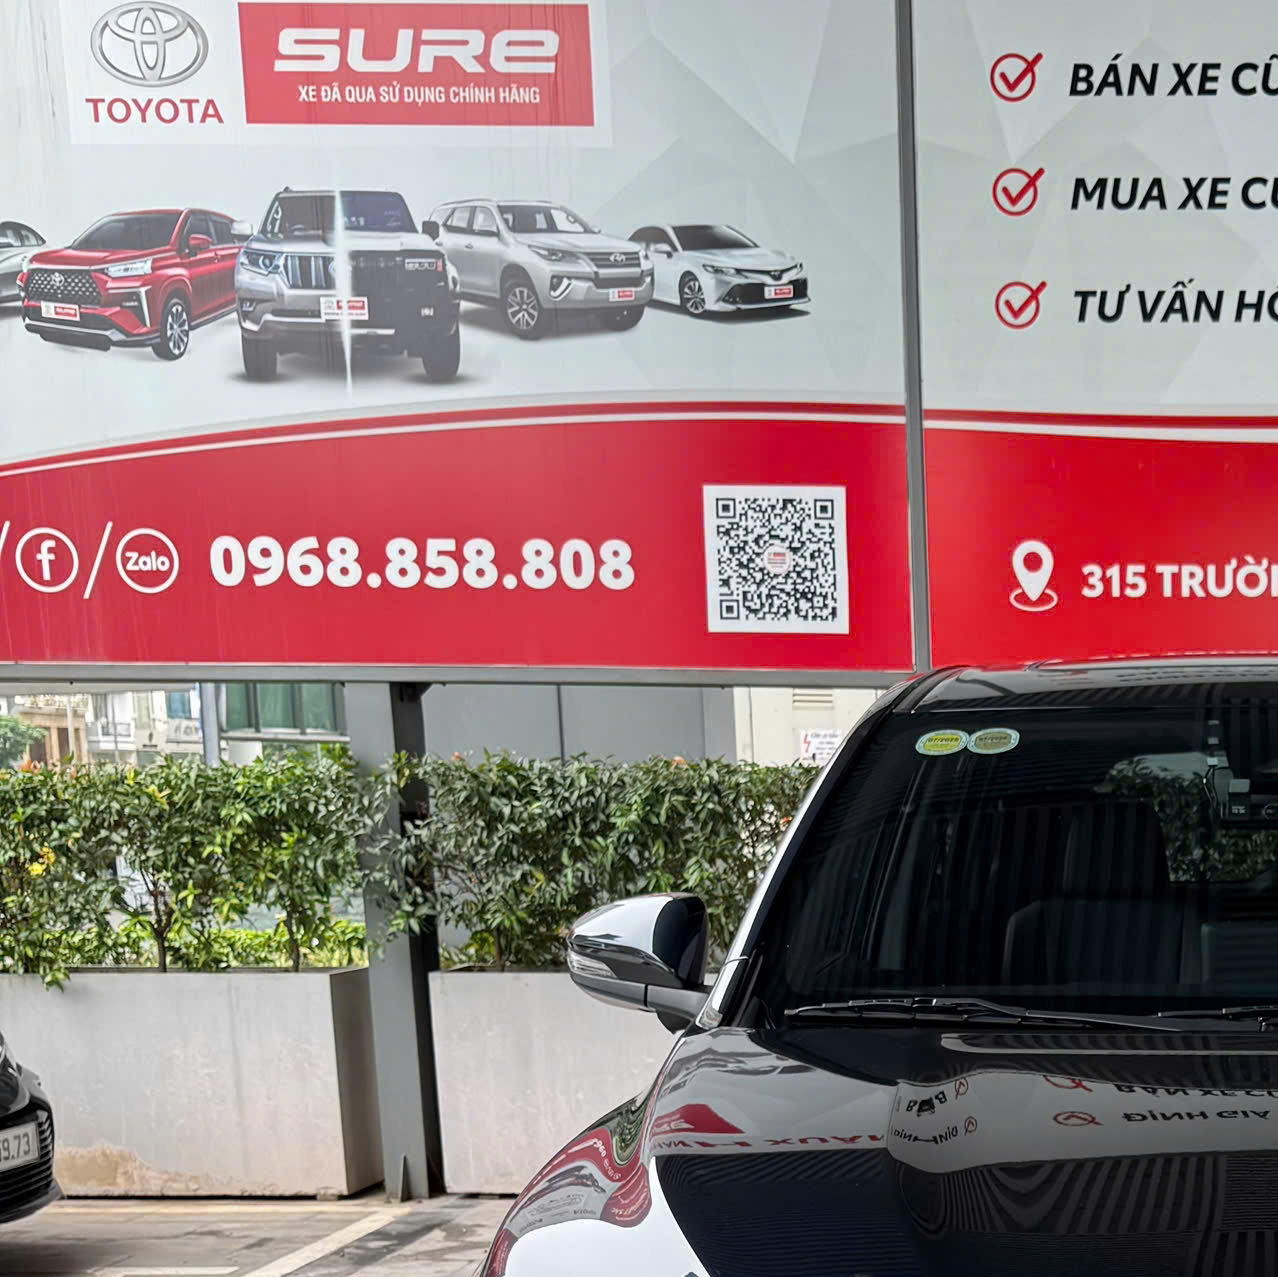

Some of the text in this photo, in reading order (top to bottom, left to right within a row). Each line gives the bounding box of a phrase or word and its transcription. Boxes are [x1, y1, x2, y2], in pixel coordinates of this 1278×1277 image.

[273, 27, 560, 74] SURE
[1069, 53, 1160, 97] BÁN
[1166, 62, 1222, 97] XE
[298, 81, 541, 107] XE ĐÃ QUA SỬ DỤNG CHÍNH HÃNG
[85, 98, 224, 125] TOYOTA
[1071, 177, 1168, 211] MUA
[1177, 177, 1232, 210] XE
[1074, 283, 1131, 323] TƯ
[1137, 278, 1225, 323] VẤN
[124, 550, 171, 572] Zalo
[210, 535, 635, 590] 0968.858.808
[1082, 564, 1147, 598] 315
